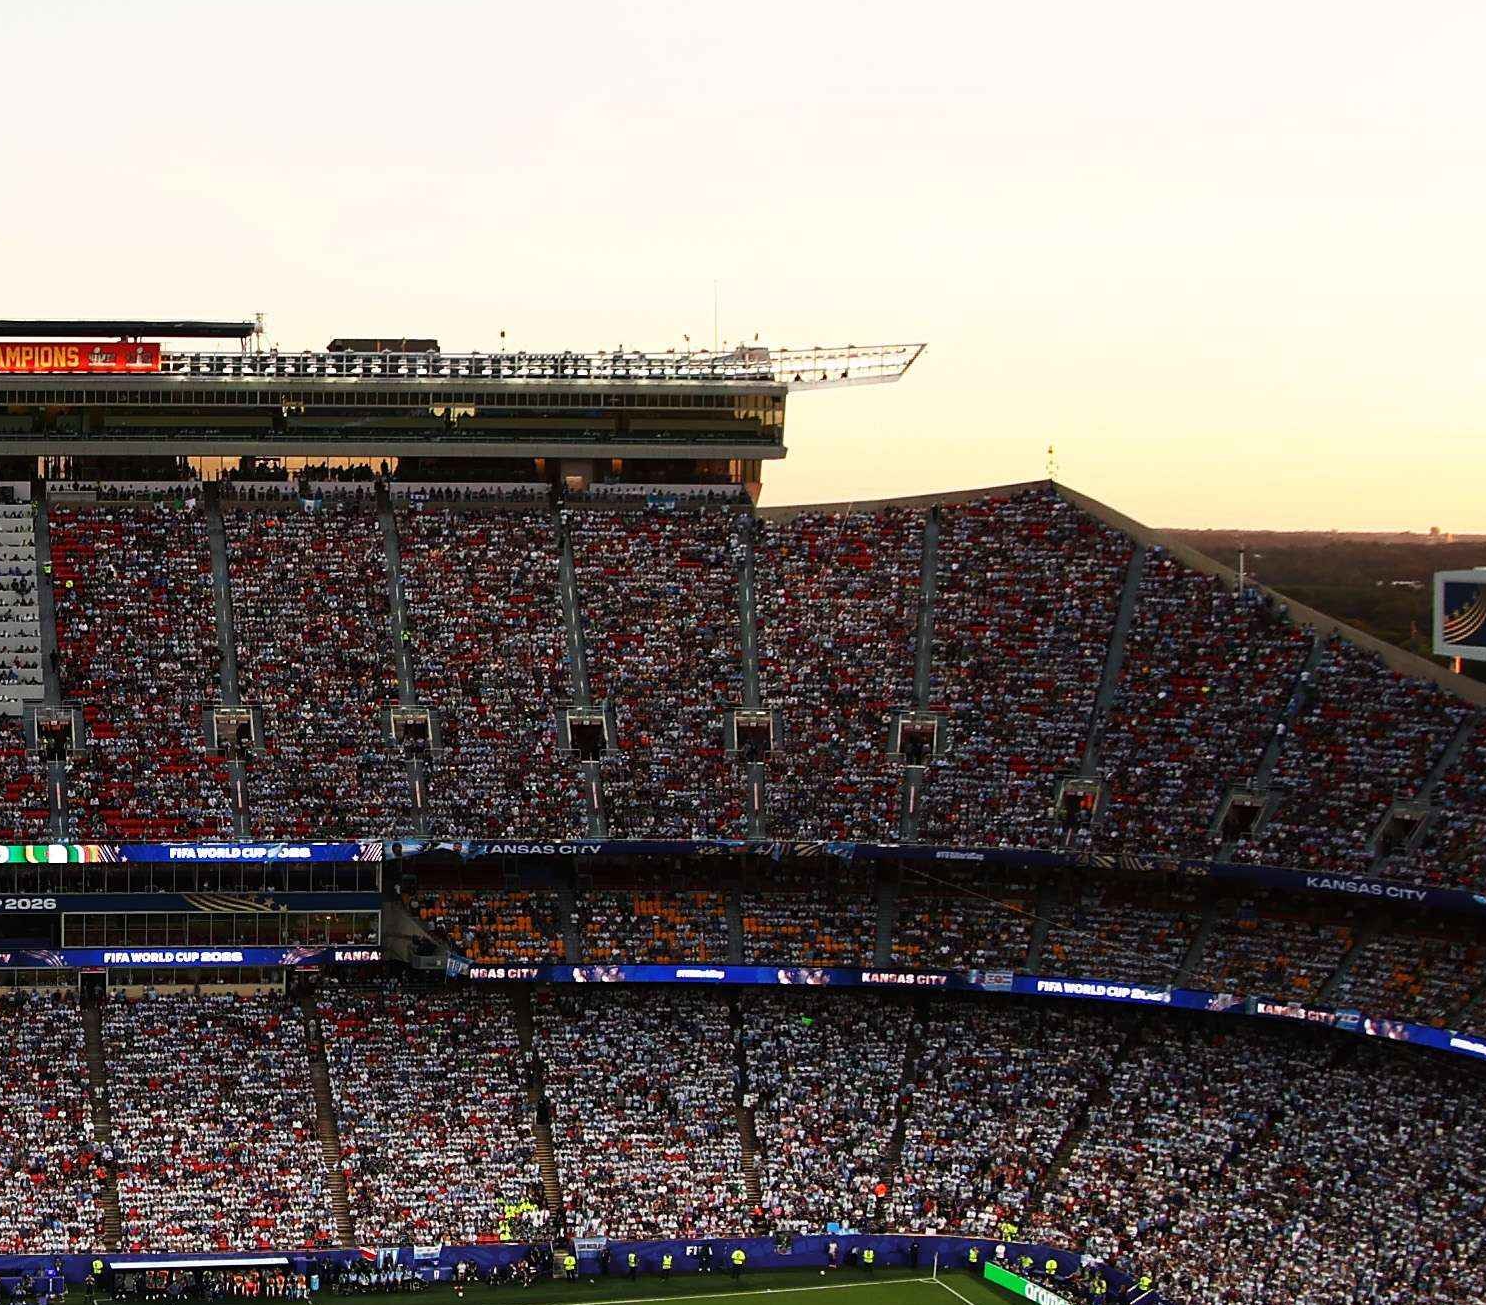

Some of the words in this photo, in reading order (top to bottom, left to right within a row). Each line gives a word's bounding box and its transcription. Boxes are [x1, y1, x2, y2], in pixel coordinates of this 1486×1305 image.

[169, 847, 197, 859] FIFA
[196, 847, 241, 858] WORLD
[241, 847, 267, 858] CUP
[268, 846, 312, 857] 026
[558, 844, 602, 855] CITY
[1306, 876, 1383, 896] KANSAS
[1385, 886, 1428, 902] CITY
[4, 898, 57, 910] 2026
[103, 953, 130, 964] FIFA
[130, 952, 175, 963] WORLD
[175, 952, 201, 962] CUP
[200, 952, 244, 962] 2026
[335, 951, 381, 961] KANSA
[470, 968, 506, 980] NSAS
[507, 968, 539, 979] CITY
[861, 972, 915, 984] KANSAS
[916, 974, 947, 985] CITY
[1037, 981, 1063, 993] FIFA
[1063, 982, 1106, 996] WORLD
[1106, 986, 1131, 998] CUP
[1130, 987, 1171, 1003] 2026
